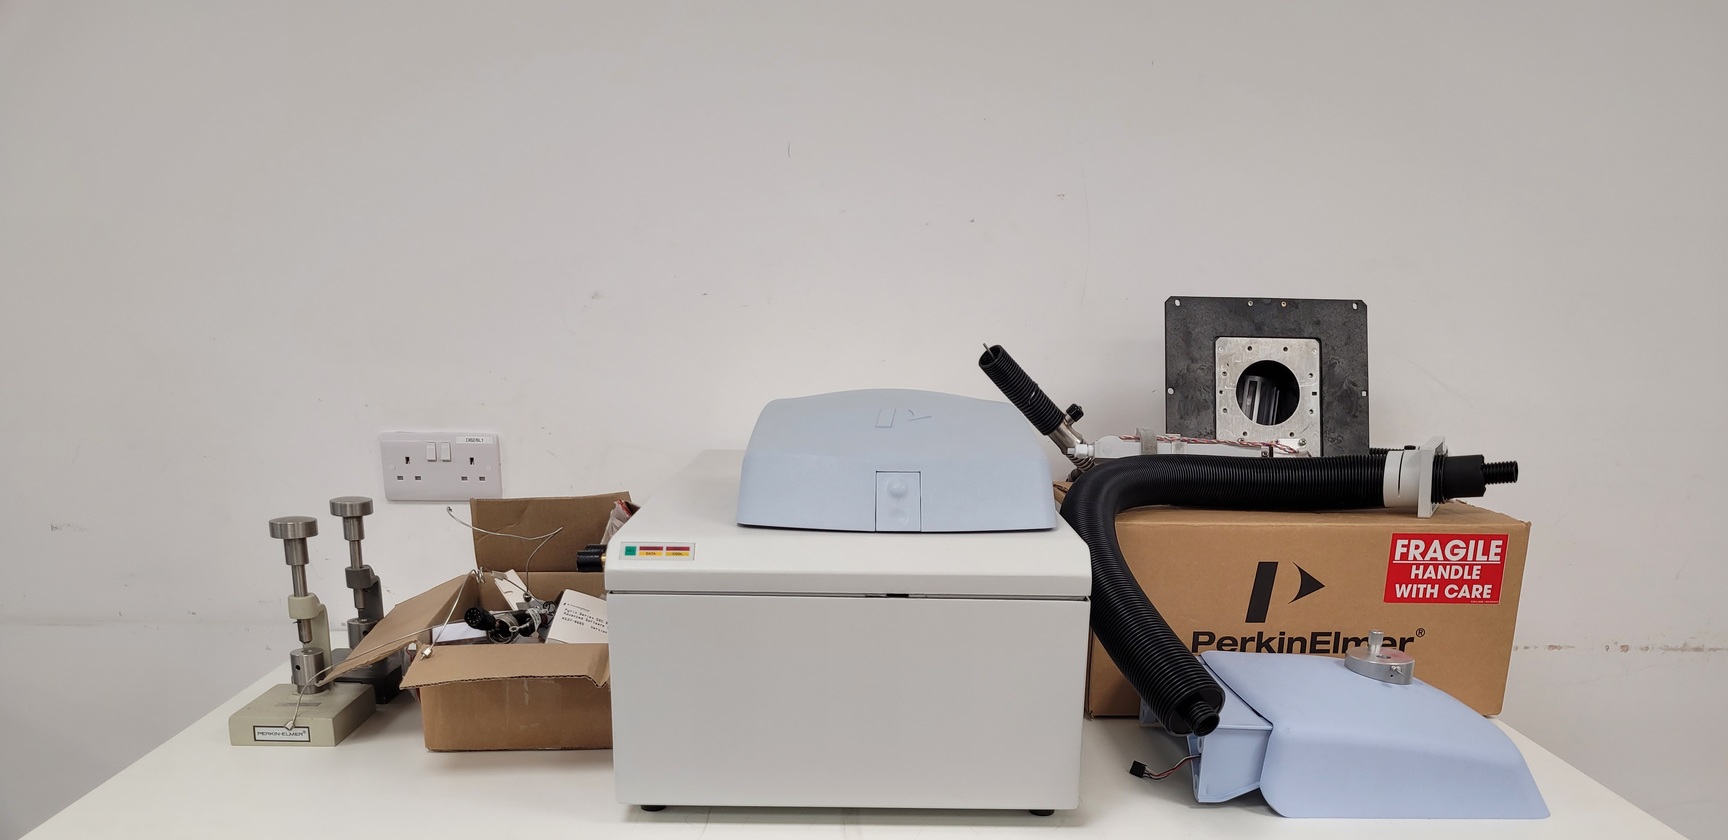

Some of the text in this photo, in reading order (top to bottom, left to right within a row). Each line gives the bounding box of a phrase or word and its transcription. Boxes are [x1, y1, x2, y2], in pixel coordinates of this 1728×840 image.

[1394, 539, 1503, 561] FRAGILE
[1410, 564, 1482, 580] HANDLE
[1395, 583, 1493, 599] WITH CARE
